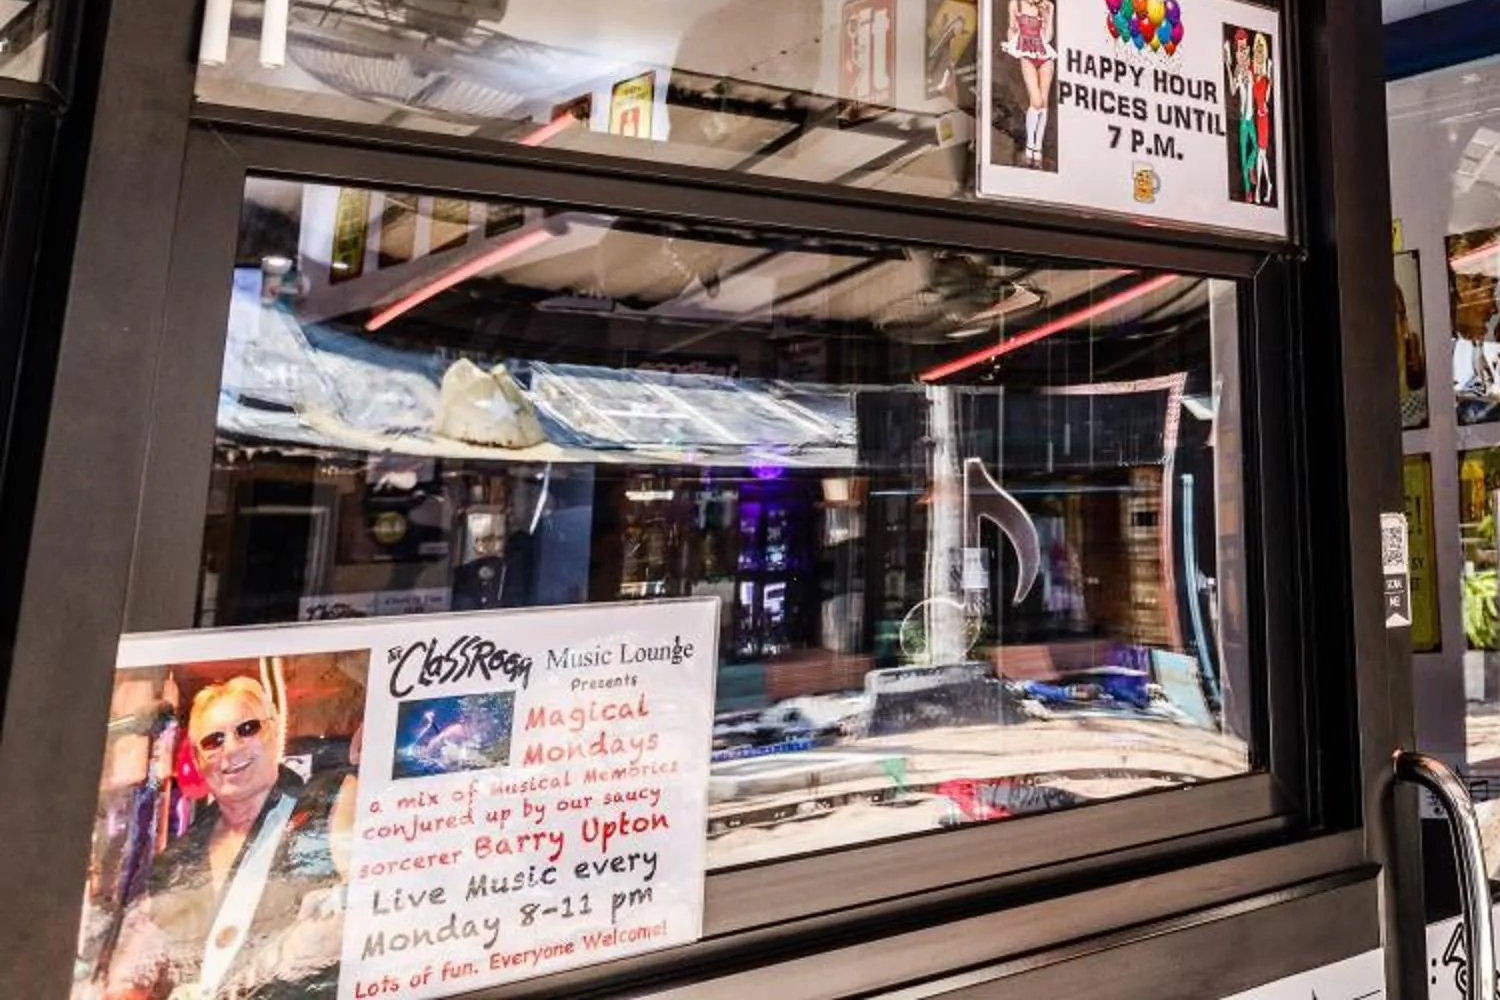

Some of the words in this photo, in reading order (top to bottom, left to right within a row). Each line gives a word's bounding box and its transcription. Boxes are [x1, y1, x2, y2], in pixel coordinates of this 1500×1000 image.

[1067, 48, 1145, 87] HAPPY
[1153, 69, 1218, 104] HOUR
[1058, 80, 1148, 121] PRICES
[1157, 103, 1226, 137] UNTIL
[1107, 124, 1122, 149] 7
[1131, 129, 1184, 160] P.M.
[546, 648, 612, 671] Music
[620, 638, 694, 666] Lounge
[571, 673, 638, 692] Presents
[524, 693, 652, 733] Magical
[522, 731, 661, 767] Mondays
[363, 810, 475, 842] conjured
[486, 807, 511, 829] up
[523, 798, 545, 825] by
[556, 796, 591, 812] our
[603, 785, 662, 807] saucy
[369, 801, 384, 813] a
[397, 791, 438, 810] mix
[451, 779, 478, 801] of
[358, 850, 463, 880] sorcerer
[474, 827, 565, 862] Barry
[581, 810, 670, 853] Upton
[372, 885, 446, 917] Live
[465, 864, 557, 902] Music
[574, 849, 658, 882] every
[361, 913, 500, 961] Monday
[519, 893, 593, 928] 8-11
[611, 886, 653, 924] pm
[354, 975, 400, 1000] Lots
[409, 966, 434, 990] of
[441, 957, 479, 982] fun.
[489, 938, 575, 970] Everyone
[582, 921, 668, 950] Welcome!
